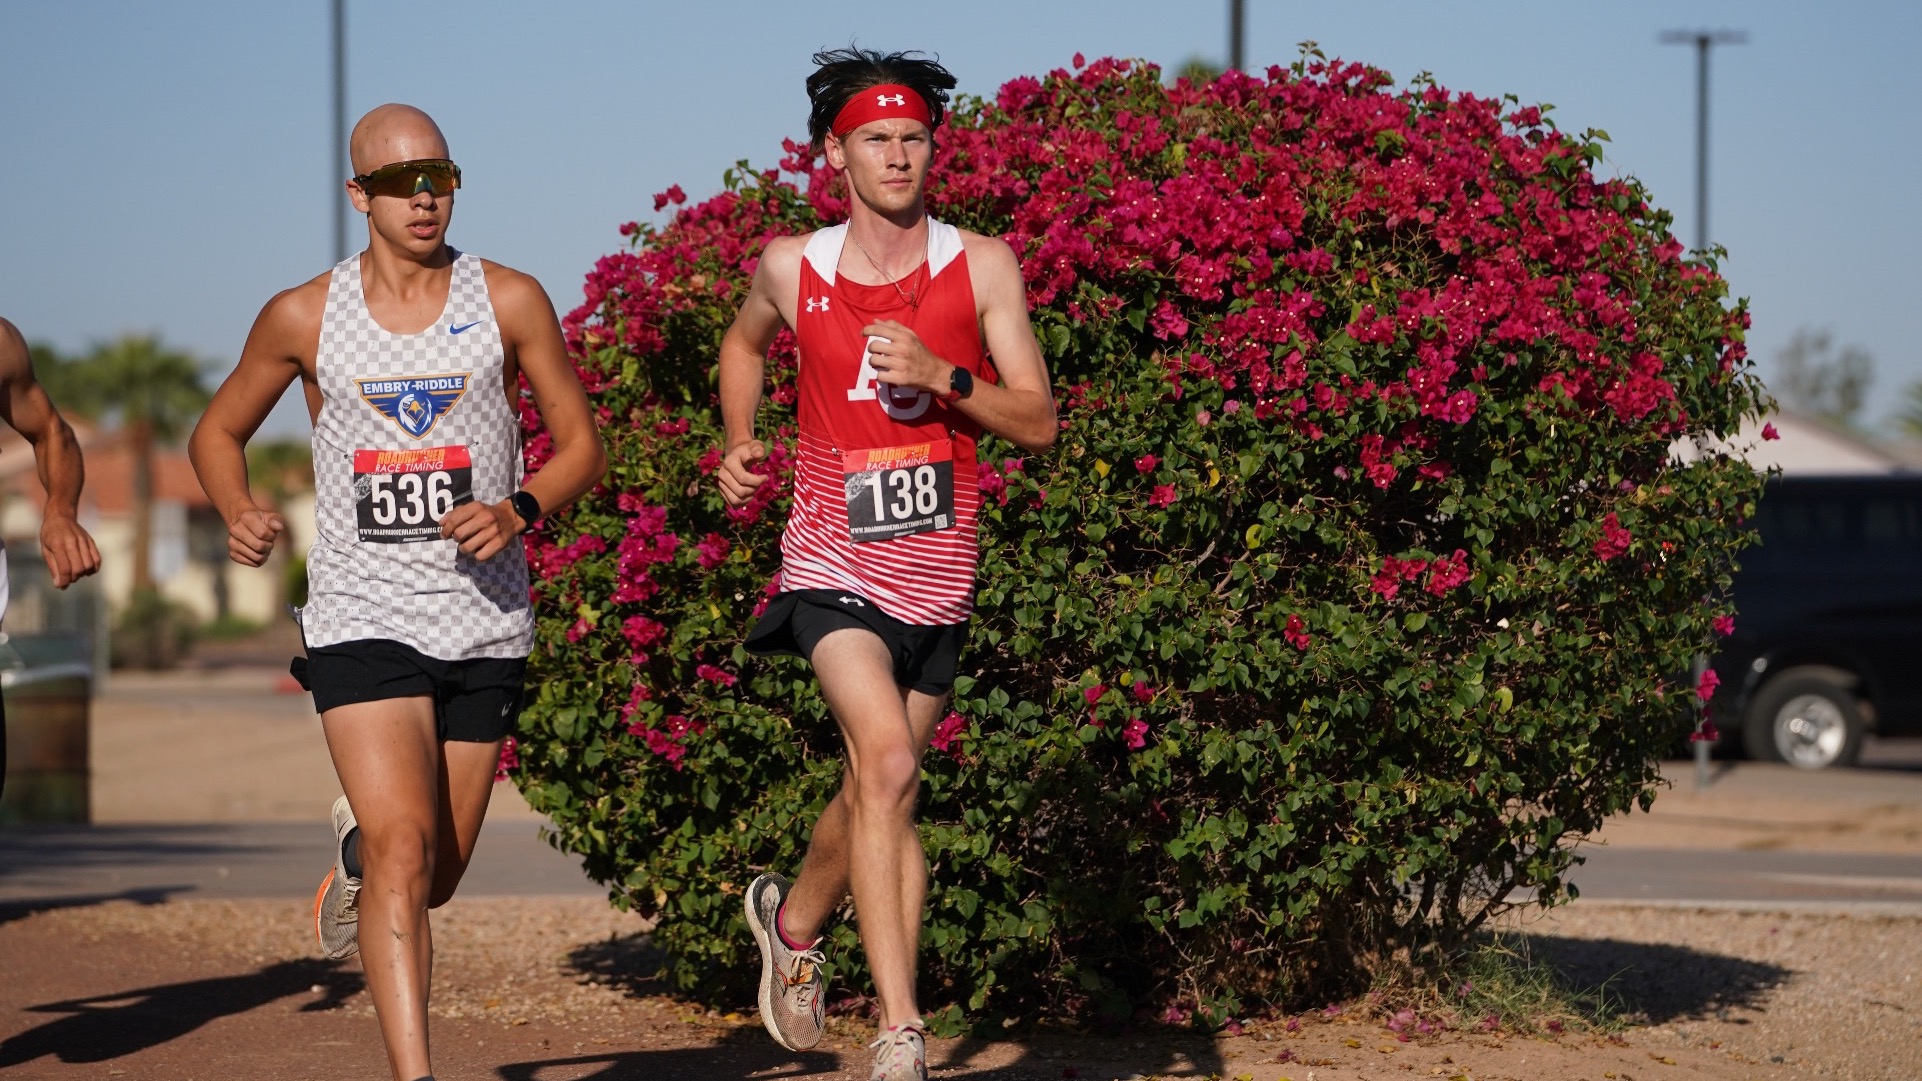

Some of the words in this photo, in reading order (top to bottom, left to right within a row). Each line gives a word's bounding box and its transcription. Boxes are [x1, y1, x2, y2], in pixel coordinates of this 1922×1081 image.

[363, 377, 463, 394] EMBRY-RIDDLE
[375, 463, 402, 473] RACE
[405, 460, 444, 472] TIMING
[866, 461, 892, 471] RACE
[895, 455, 929, 469] TIMING
[372, 471, 454, 525] 536
[864, 465, 938, 522] 138
